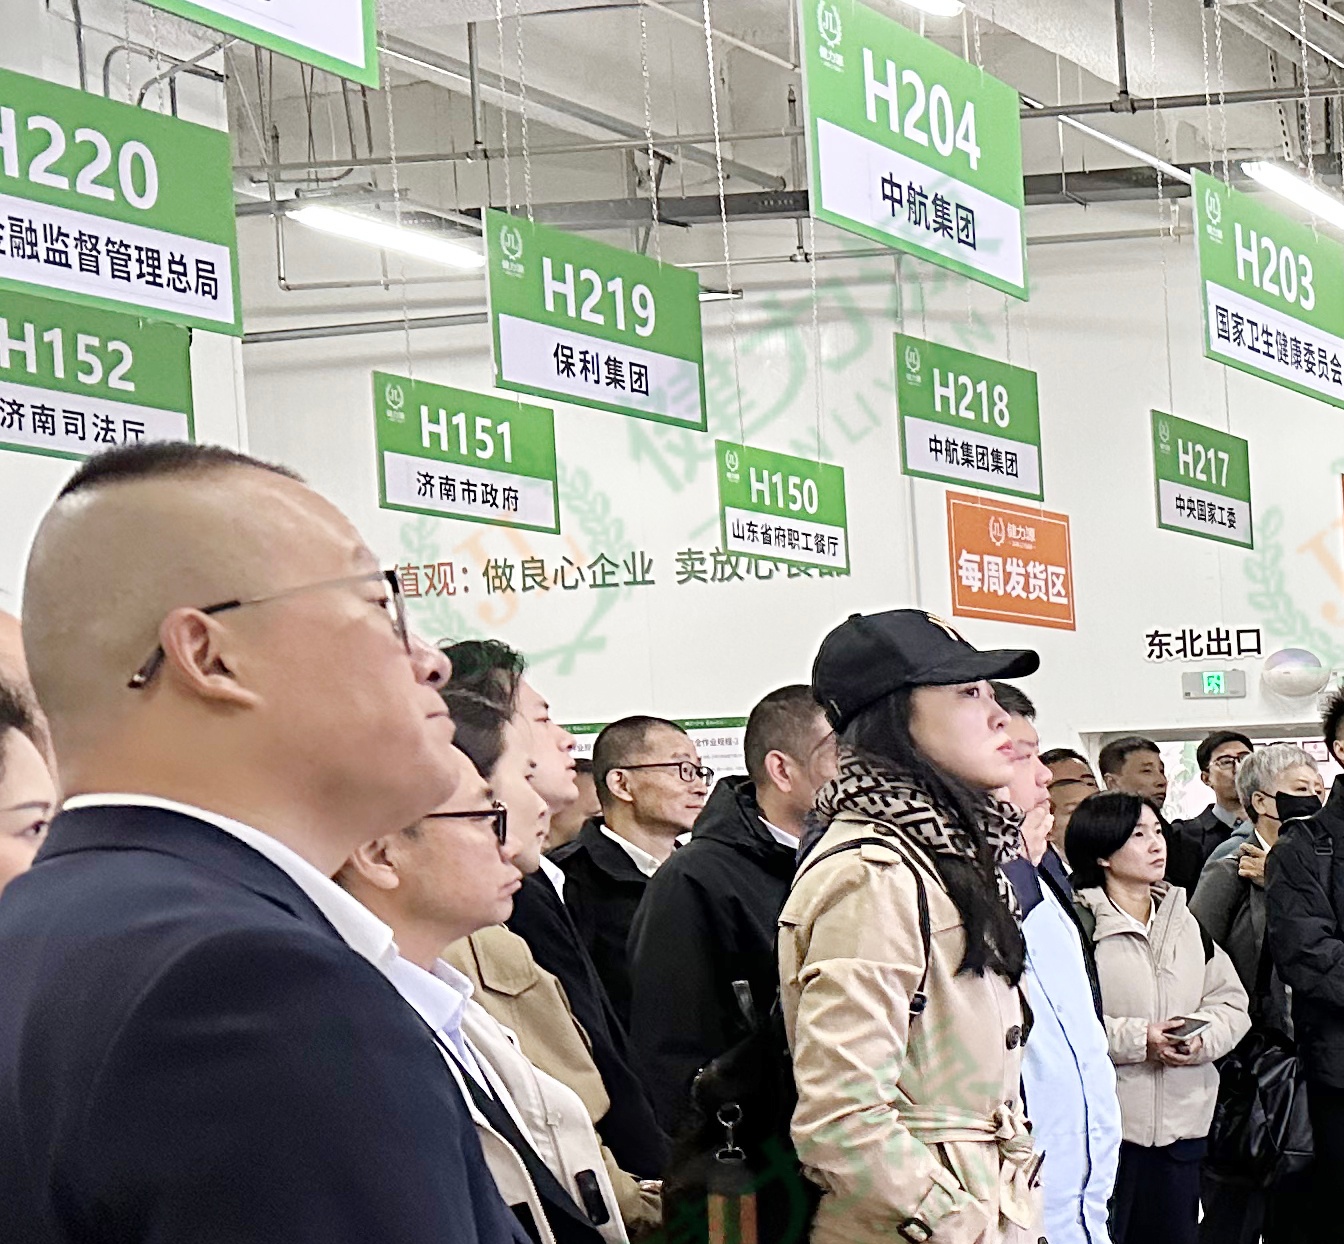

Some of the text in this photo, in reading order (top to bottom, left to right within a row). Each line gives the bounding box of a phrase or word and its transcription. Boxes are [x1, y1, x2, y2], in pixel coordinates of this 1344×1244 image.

[863, 47, 981, 171] H204
[881, 171, 977, 251] 中航集团
[0, 215, 219, 301] 融监督管理总局
[1234, 222, 1315, 311] H203
[542, 256, 656, 337] H219
[0, 317, 136, 392] H152
[553, 343, 650, 397] 保利集团
[1215, 304, 1343, 386] 国家卫生健康委员会
[933, 367, 1010, 429] H218
[420, 404, 513, 464] H151
[928, 434, 1019, 478] 中航集团集团
[1177, 438, 1229, 487] H217
[416, 470, 520, 512] 济南市政府
[749, 466, 819, 514] H150
[732, 518, 838, 557] 山东省府职工餐厅
[958, 548, 1069, 605] 每周发货区
[1145, 627, 1262, 659] 东北出口
